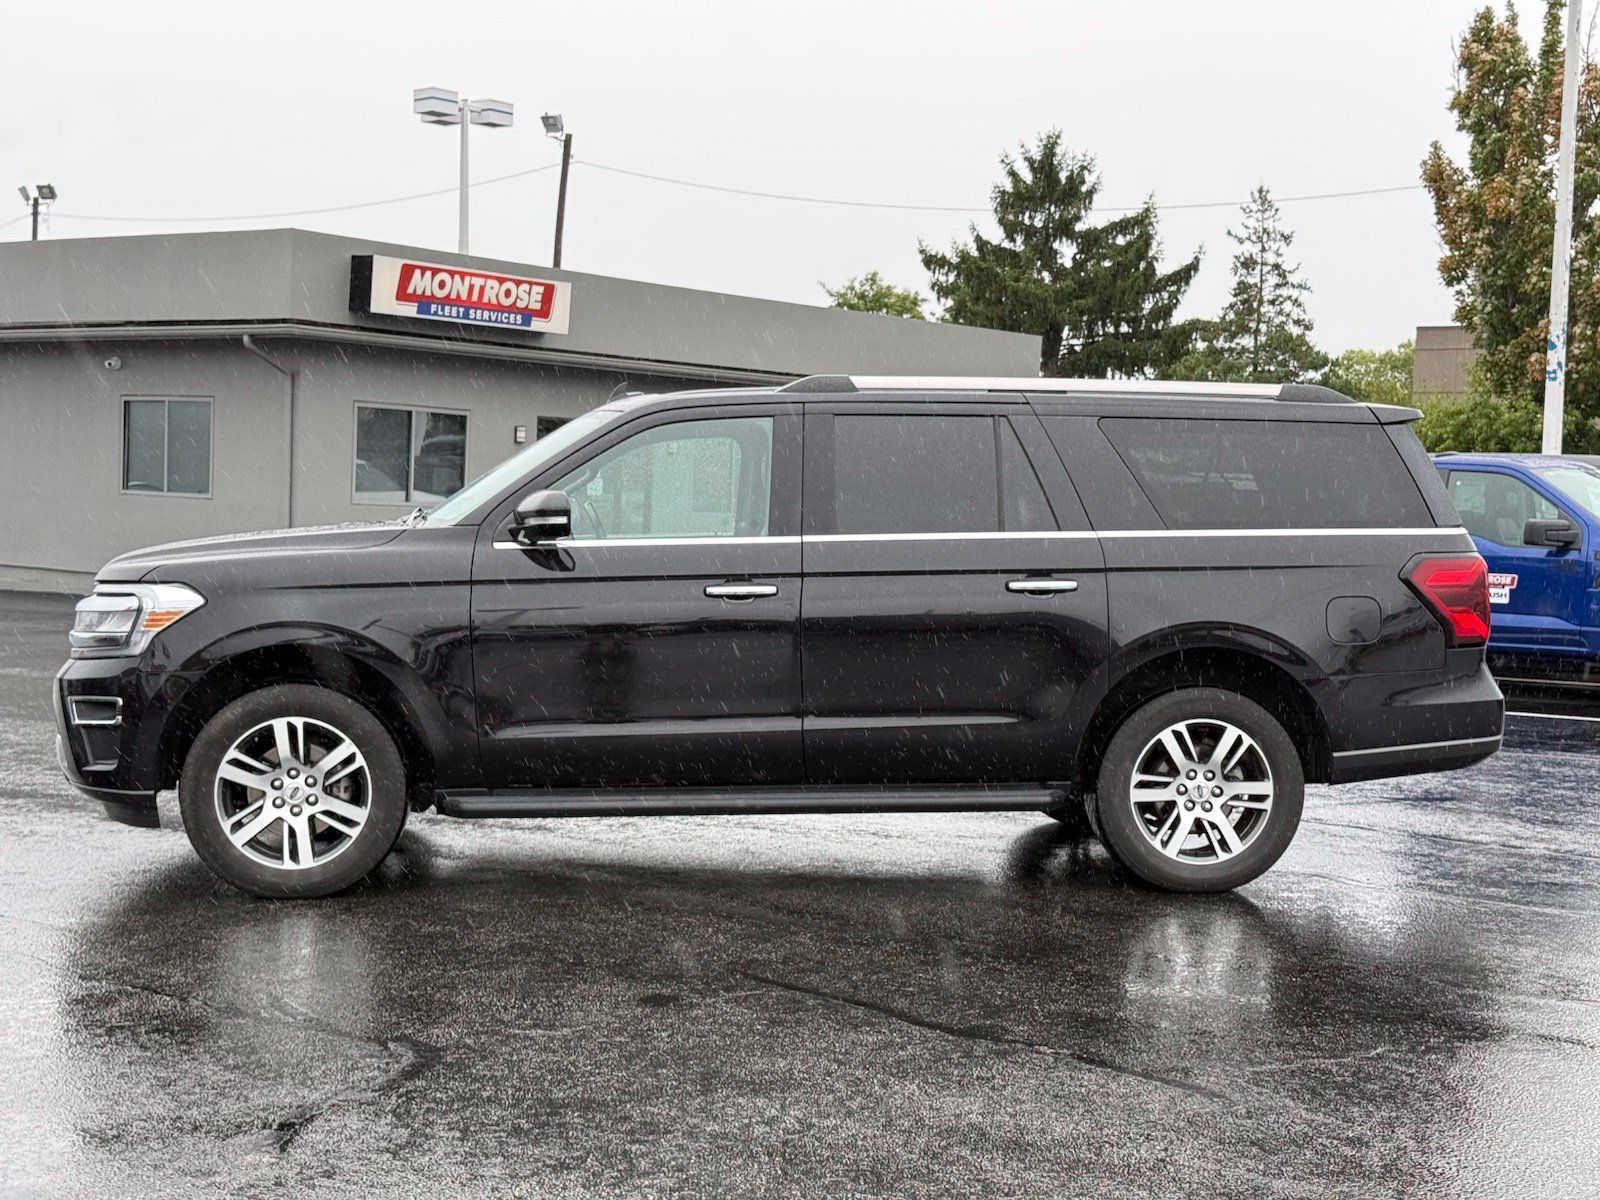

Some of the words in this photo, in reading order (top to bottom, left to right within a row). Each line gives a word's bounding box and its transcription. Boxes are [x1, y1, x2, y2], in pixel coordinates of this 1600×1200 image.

[407, 268, 544, 310] MONTROSE
[430, 304, 464, 318] FLEET
[469, 308, 522, 324] SERVICES
